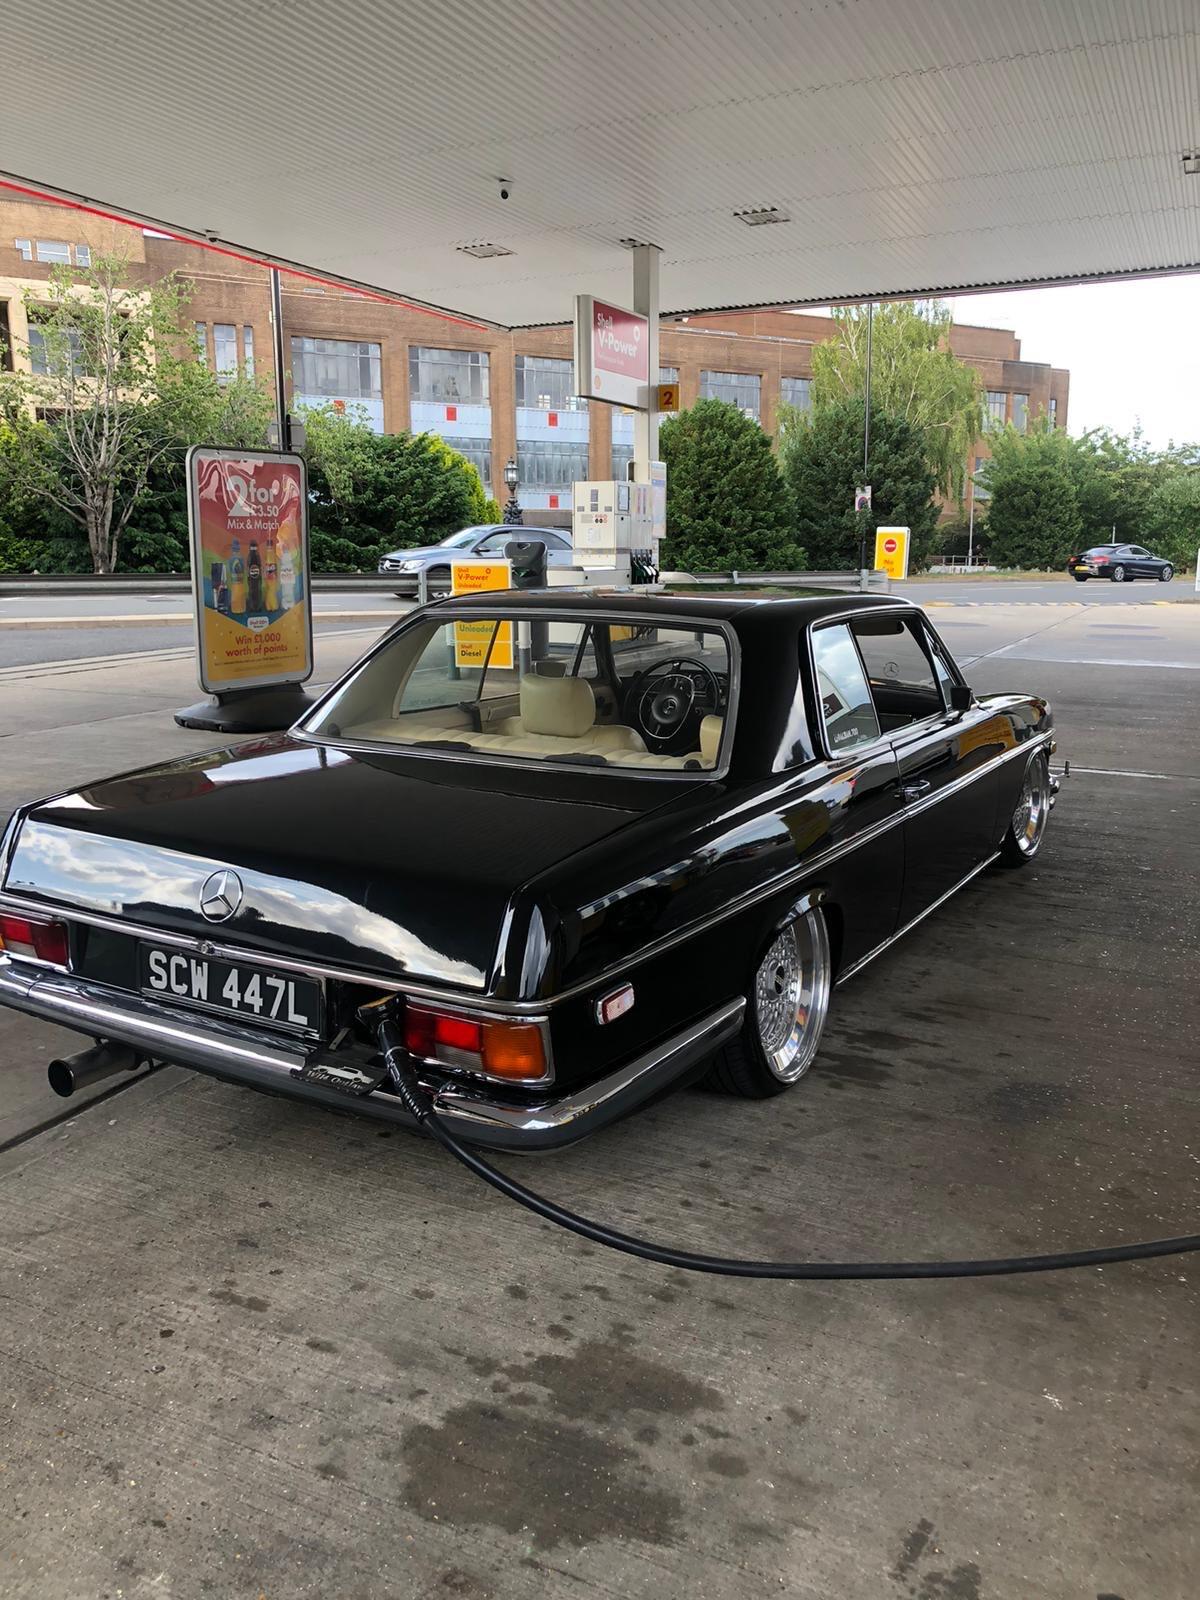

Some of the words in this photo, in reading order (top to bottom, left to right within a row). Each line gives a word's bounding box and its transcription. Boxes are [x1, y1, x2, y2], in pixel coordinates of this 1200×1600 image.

[597, 313, 613, 330] Shell
[598, 328, 638, 358] V-Power
[663, 390, 673, 406] 2
[228, 475, 251, 517] 2
[249, 479, 276, 503] for
[227, 519, 245, 530] Mix
[245, 519, 253, 530] &
[254, 519, 280, 530] Match
[457, 573, 489, 581] V-Power
[459, 624, 494, 632] Unleaded
[235, 635, 252, 645] Win
[255, 632, 281, 645] £1,000
[225, 646, 252, 657] worth
[253, 645, 262, 655] of
[264, 643, 288, 656] points
[461, 649, 482, 657] Diesel
[149, 950, 209, 1001] SCW
[222, 968, 309, 1026] 447L
